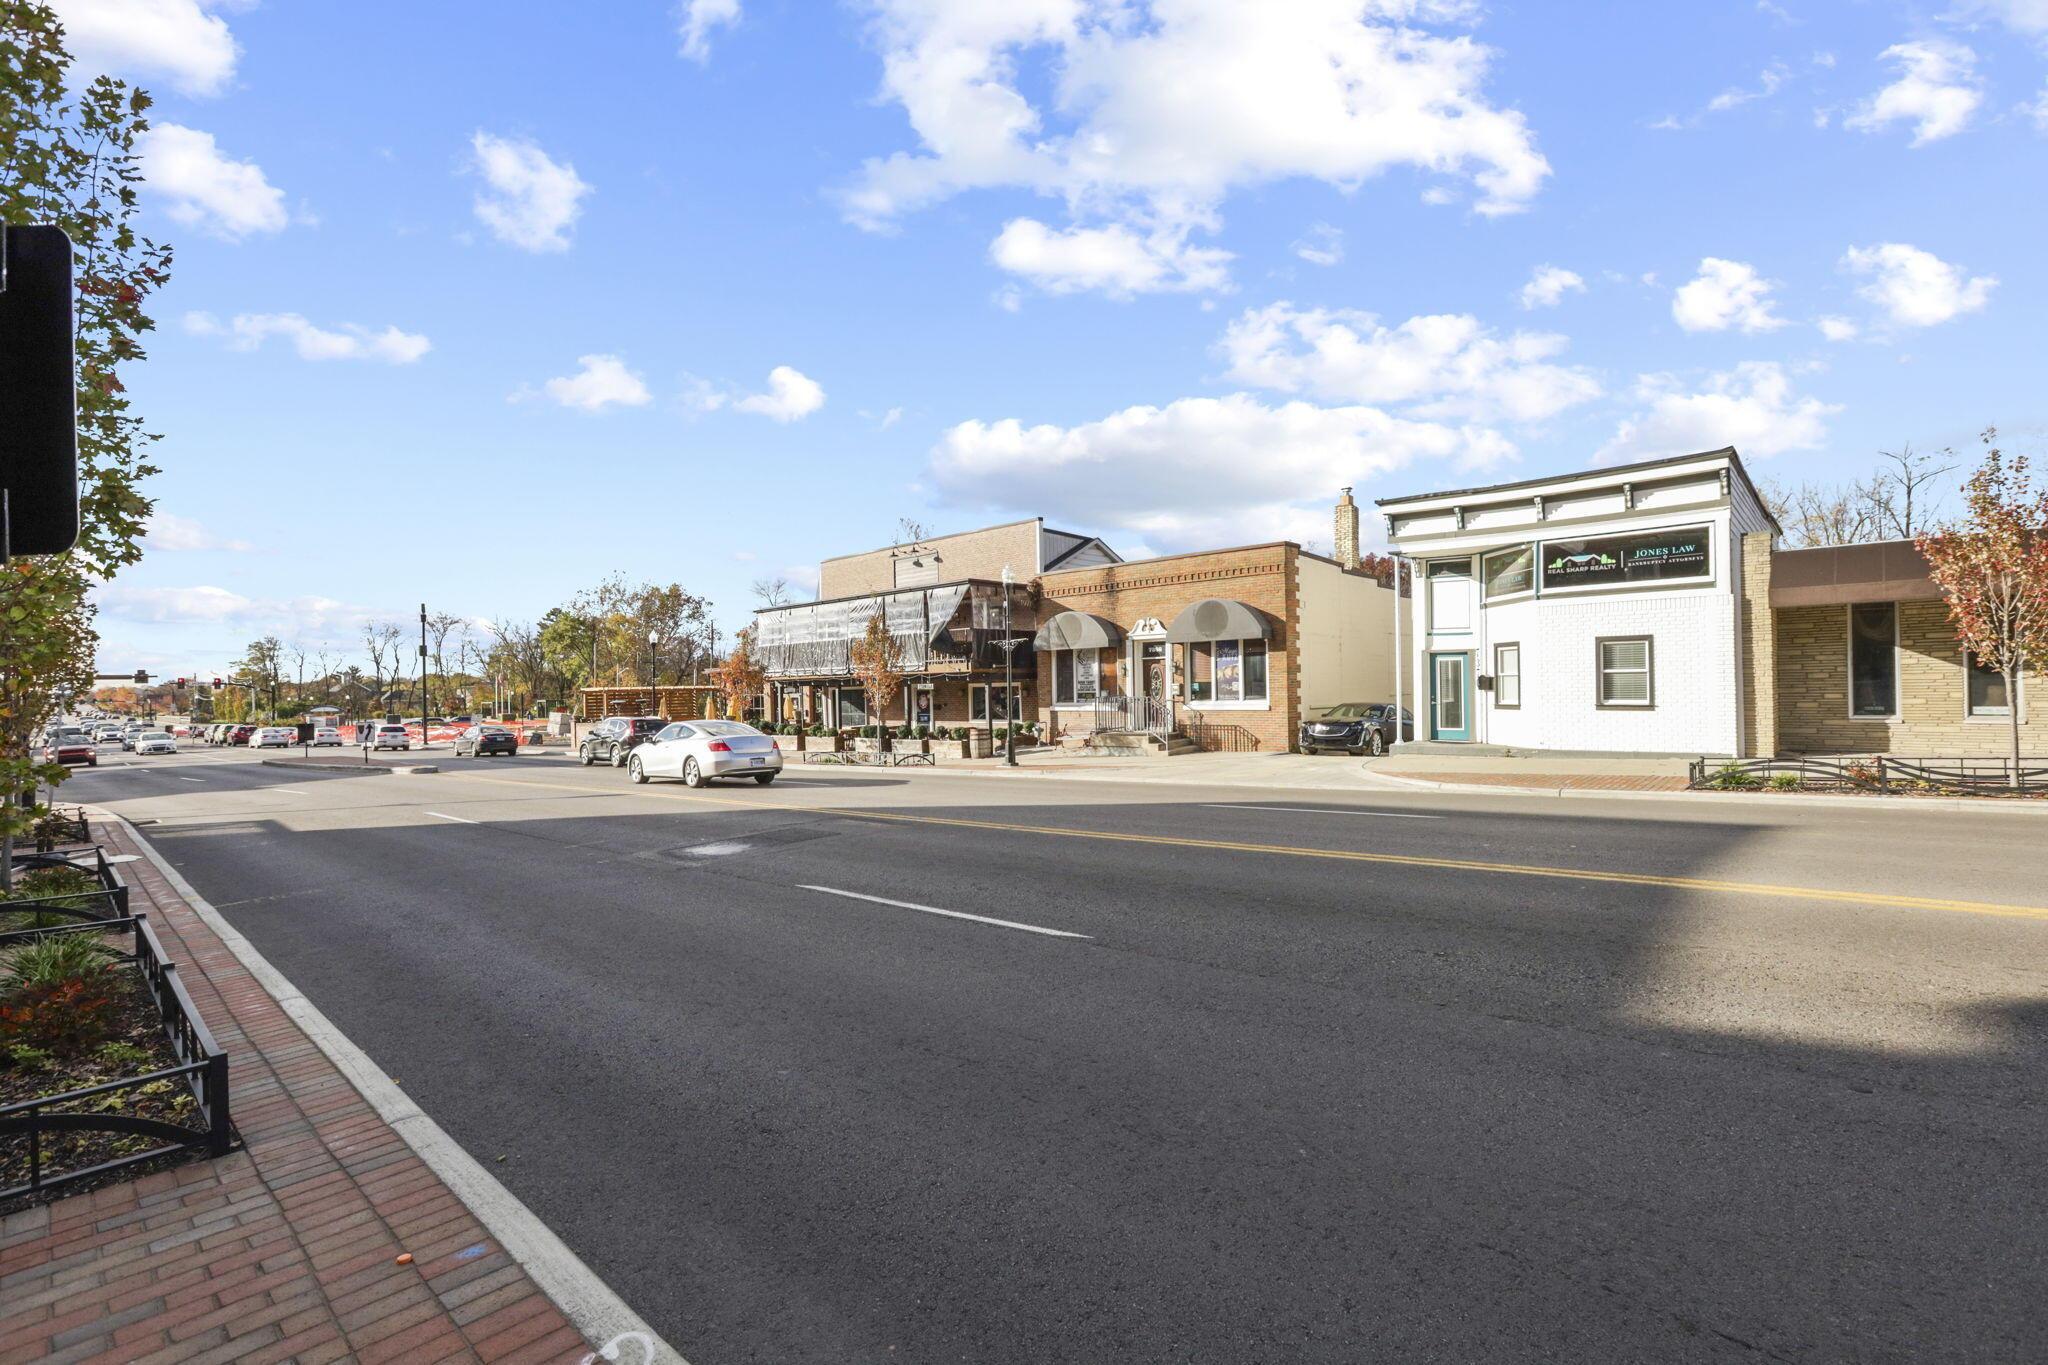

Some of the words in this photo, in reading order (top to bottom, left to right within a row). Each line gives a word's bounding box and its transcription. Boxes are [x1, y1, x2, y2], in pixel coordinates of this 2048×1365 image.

[1634, 547, 1669, 558] JONES
[1672, 544, 1696, 554] LAW
[1590, 563, 1617, 571] REALTY
[1628, 559, 1666, 567] BANKRUPTCY
